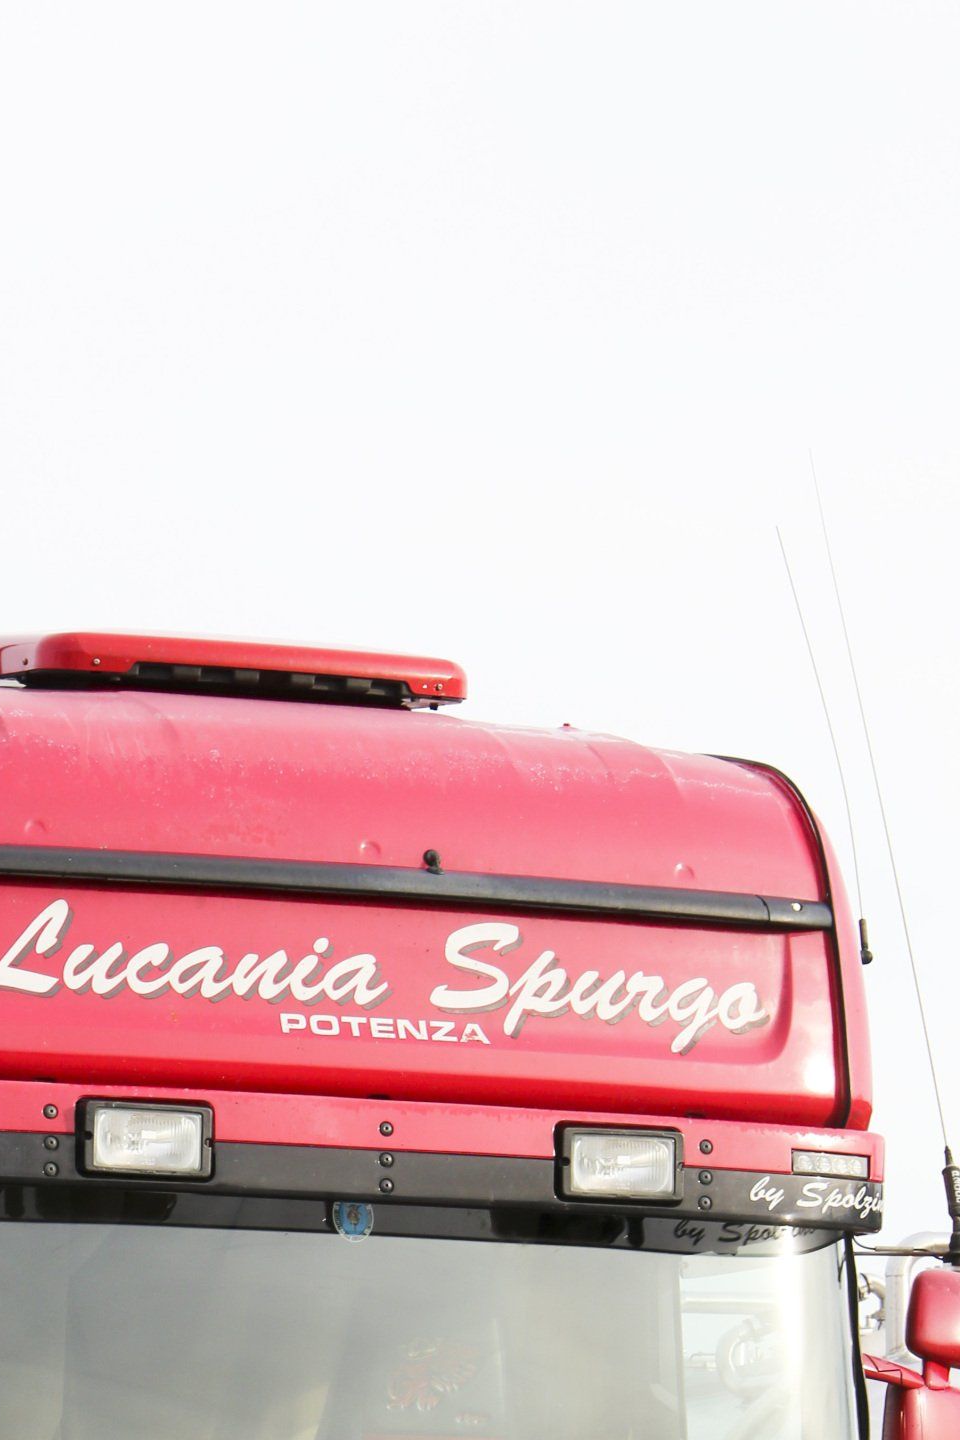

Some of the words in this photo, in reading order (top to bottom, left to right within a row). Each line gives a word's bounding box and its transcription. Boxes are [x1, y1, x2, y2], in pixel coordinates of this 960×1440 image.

[431, 922, 769, 1055] Spurgo
[280, 1011, 491, 1045] POTENZA
[750, 1176, 785, 1211] by
